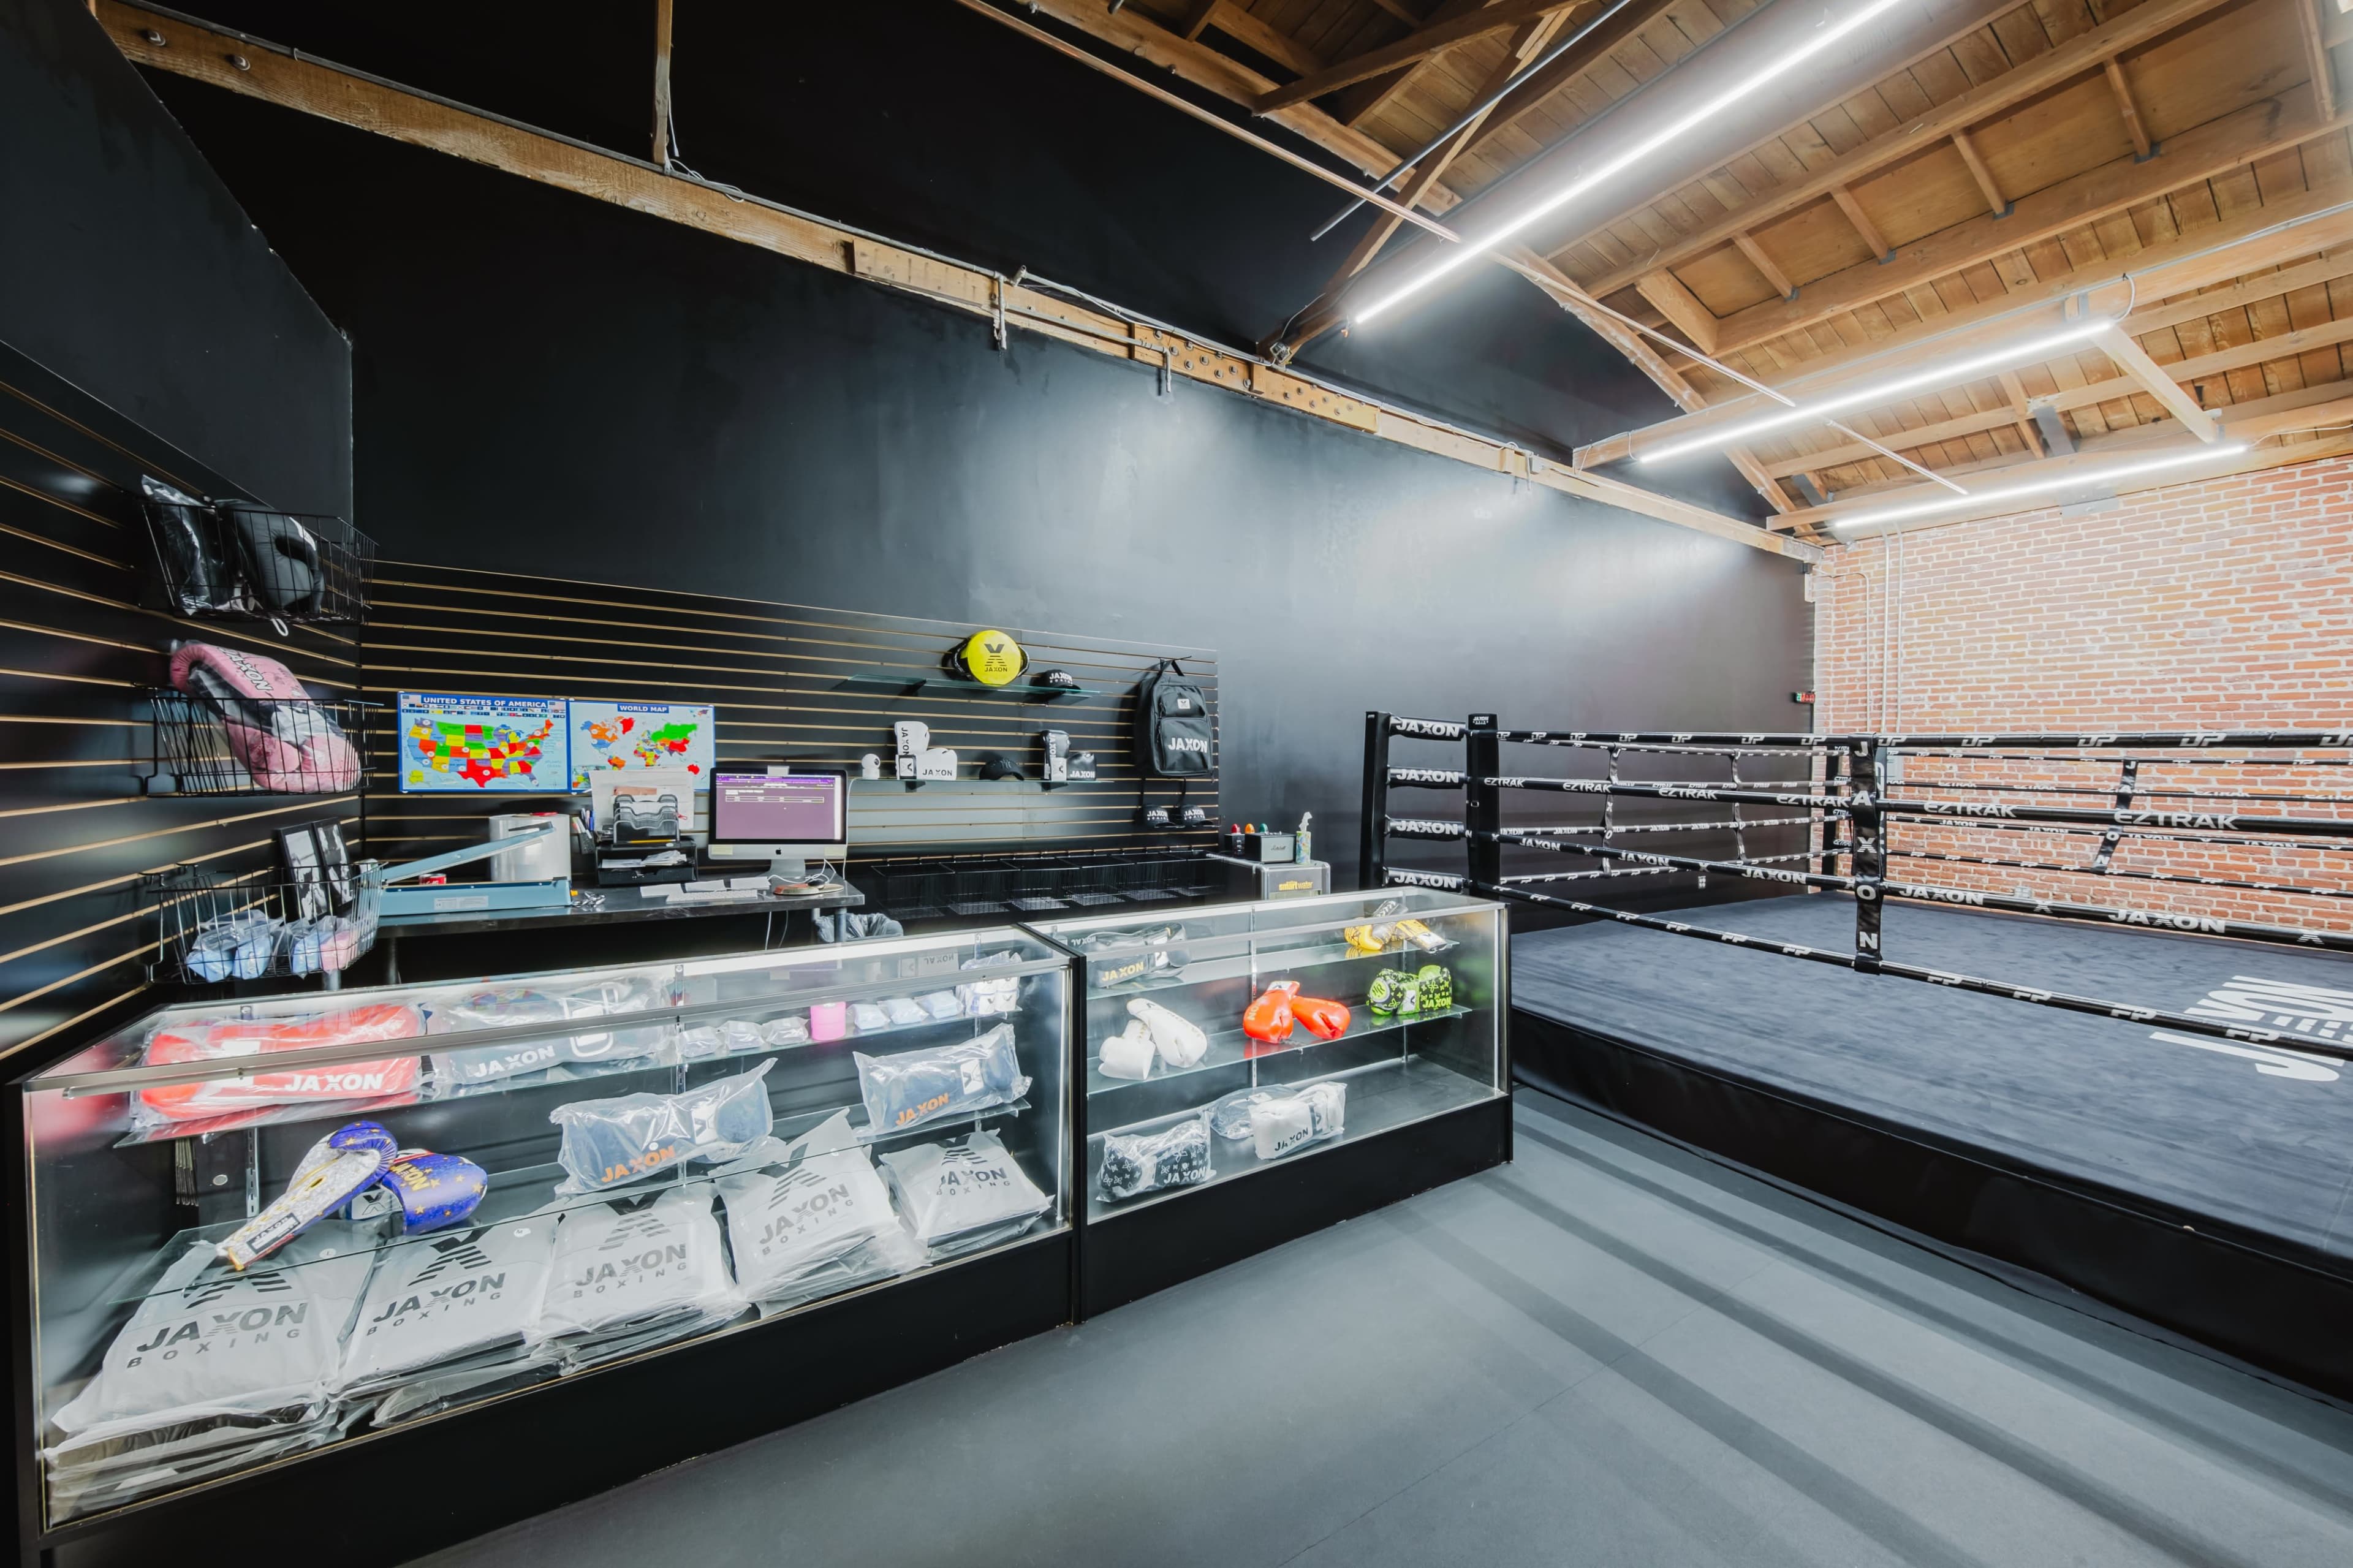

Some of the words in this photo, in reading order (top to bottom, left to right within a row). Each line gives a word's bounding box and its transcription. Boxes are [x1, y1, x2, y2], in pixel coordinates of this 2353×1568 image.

[1396, 718, 1460, 737] JAXON
[1168, 737, 1207, 754] JAXON
[1396, 770, 1459, 784] JAXON
[1484, 777, 1526, 788] EZTRAK
[1563, 782, 1613, 793] EZTRAK
[1659, 787, 1718, 800] EZTRAK
[1777, 794, 1850, 808] EZTRAK
[1924, 802, 2017, 817] EZTRAK
[2114, 811, 2240, 830] EZTRAK
[1396, 820, 1458, 836] JAXON
[1394, 871, 1458, 889] JAXON
[1520, 838, 1561, 851] JAXON
[1618, 850, 1670, 866] JAXON
[1741, 868, 1806, 885] JAXON
[1899, 887, 1984, 906] JAXON
[2108, 908, 2226, 933] JAXON
[1102, 961, 1145, 982] JAXON
[1422, 998, 1452, 1009] JAXON
[474, 1044, 555, 1078] JAXON
[284, 1072, 384, 1092] JAXON
[895, 1092, 950, 1127] JAXON
[1275, 1127, 1309, 1152] JAXON
[601, 1144, 676, 1183] JAXON
[1164, 1165, 1207, 1184] JAXON
[759, 1183, 851, 1246] JAXON
[762, 1199, 854, 1256] BOXING
[573, 1263, 687, 1299] BOXING
[575, 1244, 686, 1286] JAXON
[366, 1292, 502, 1336] BOXING
[372, 1273, 506, 1323] JAXON
[136, 1302, 309, 1352] JAXON
[126, 1329, 300, 1369] BOXING
